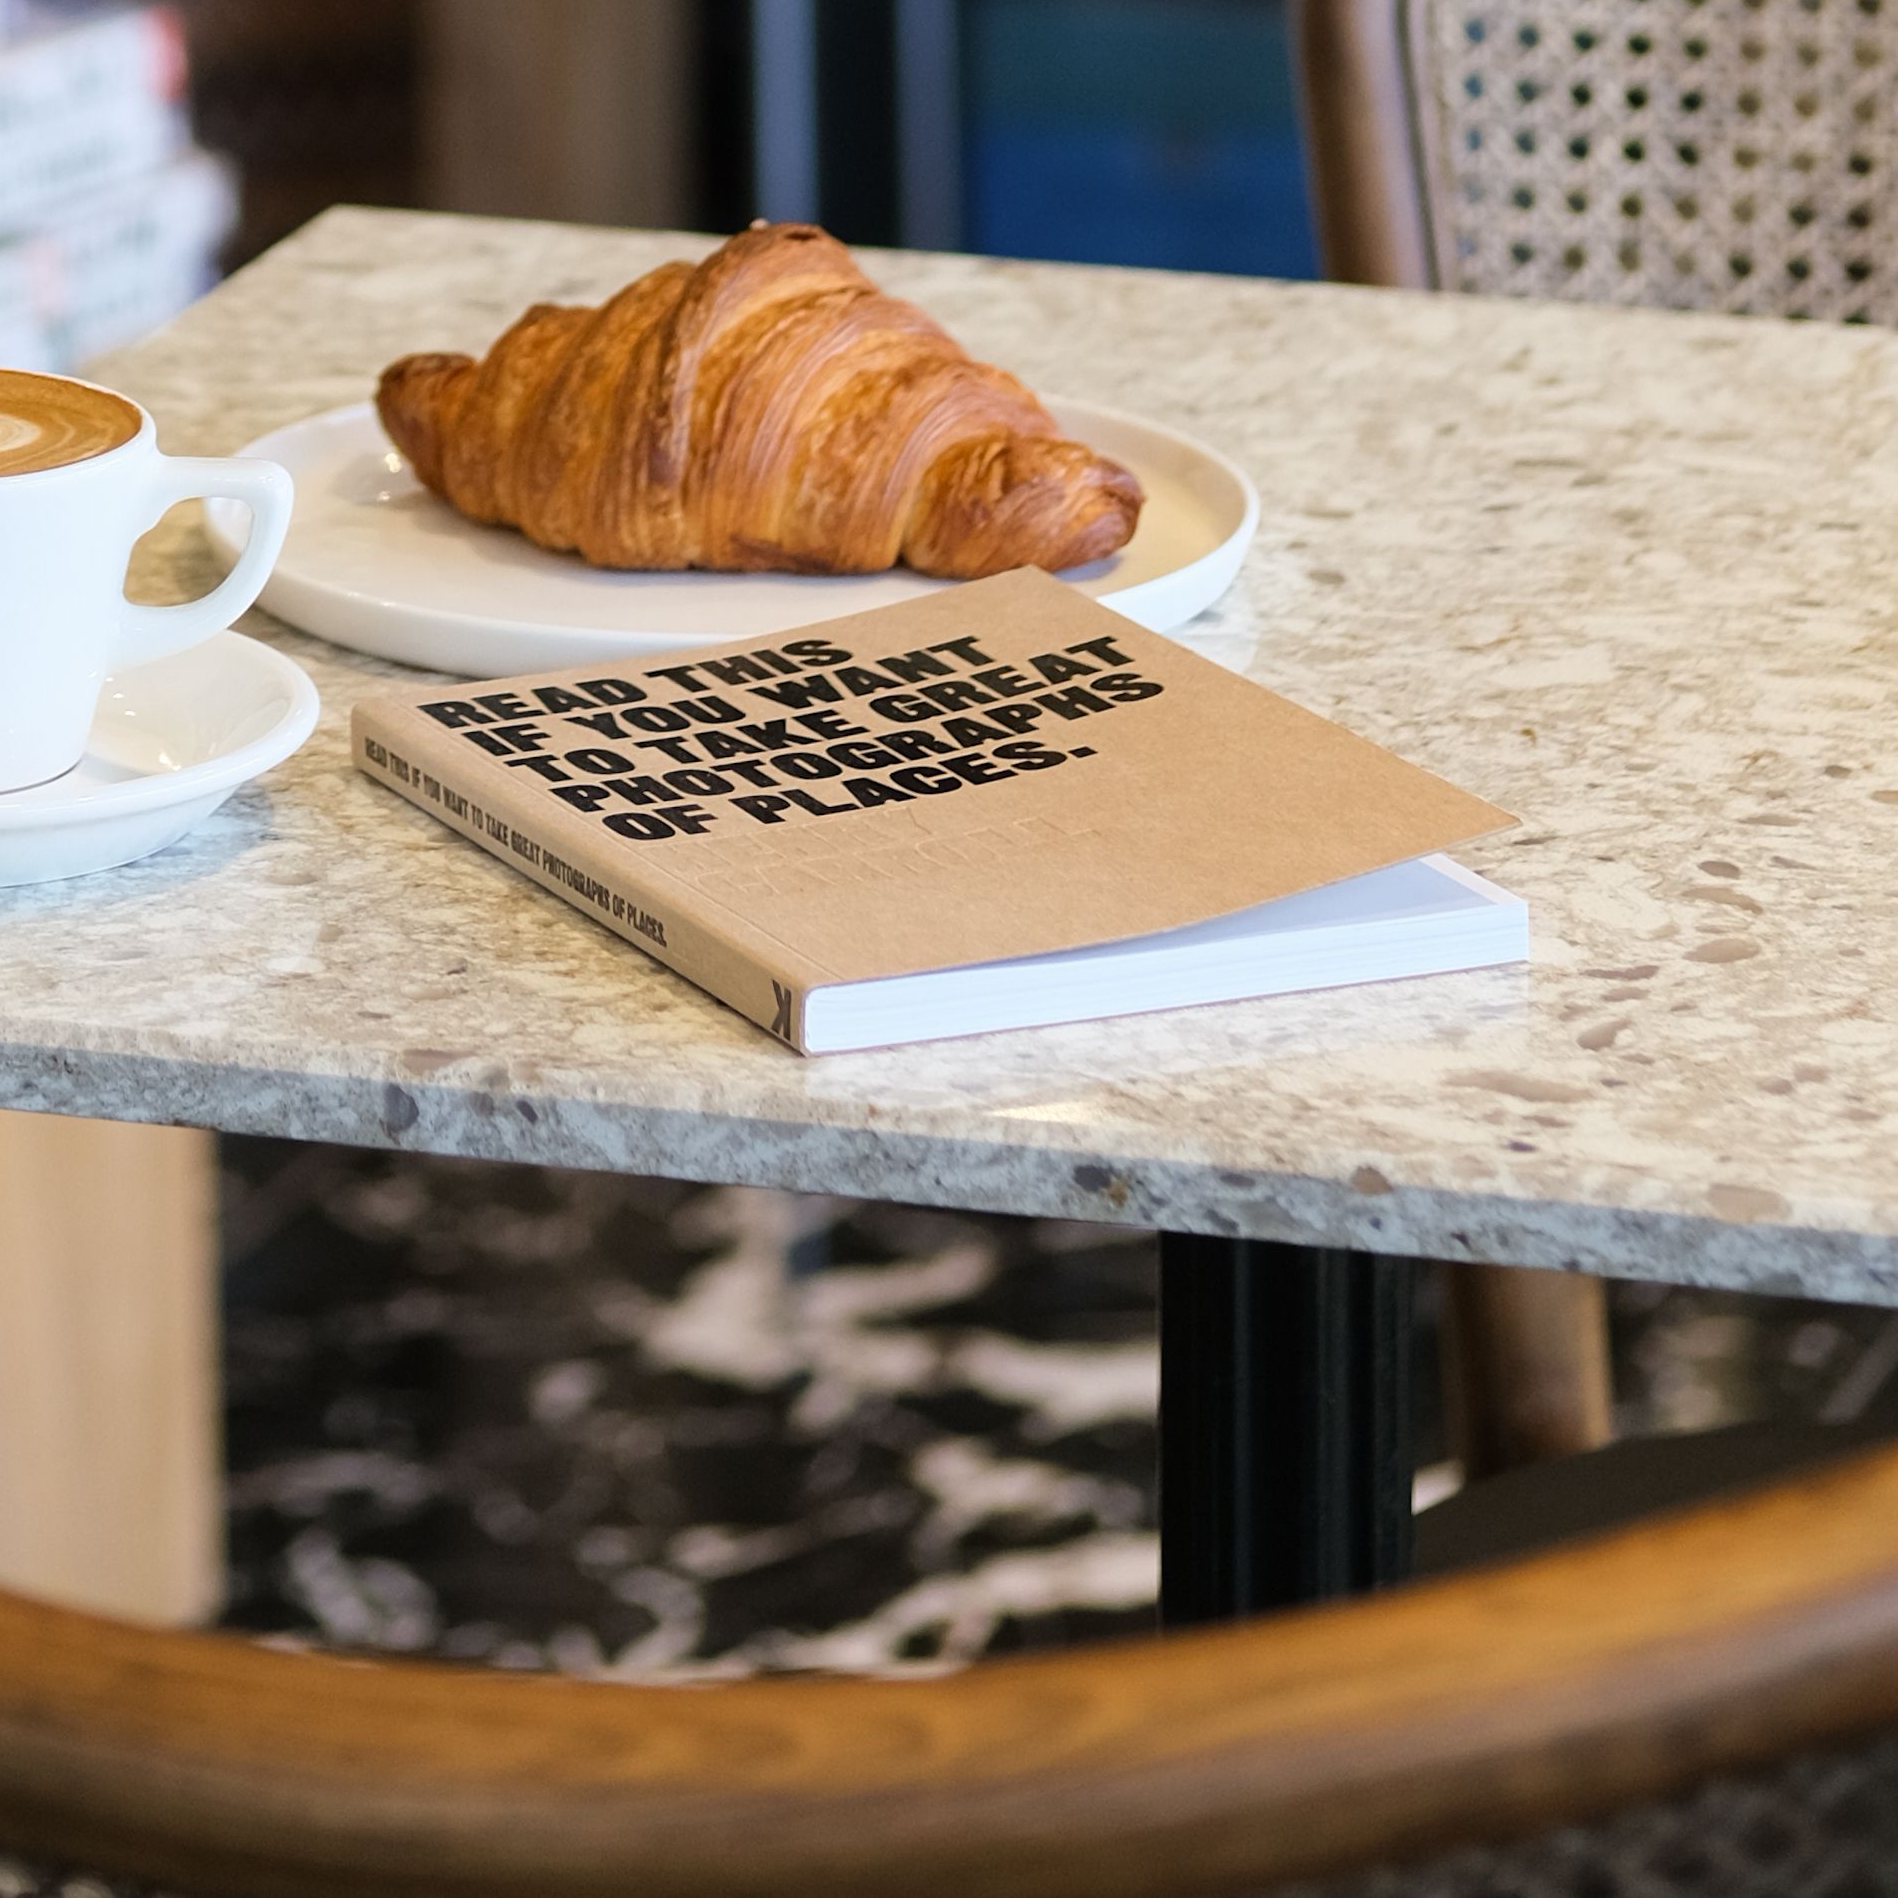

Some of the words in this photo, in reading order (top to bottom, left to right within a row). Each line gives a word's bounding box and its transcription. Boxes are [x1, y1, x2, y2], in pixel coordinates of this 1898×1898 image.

[418, 679, 647, 729] READ
[644, 640, 852, 693] THIS
[462, 724, 551, 756] IF
[564, 695, 746, 739] YOU
[747, 636, 994, 710] WANT
[504, 749, 635, 782] TO
[634, 709, 869, 763] TAKE
[870, 636, 1135, 723] GREAT
[550, 673, 1163, 812] PHOTOGRAPHS
[442, 786, 468, 820] WANT
[471, 805, 483, 830] TO
[485, 813, 509, 846] TAKE
[510, 830, 540, 865] GREAT
[542, 850, 610, 911] PHOTOGRAPHS
[612, 895, 625, 919] OF
[603, 805, 717, 840] OF
[729, 741, 1097, 824] PLACES.
